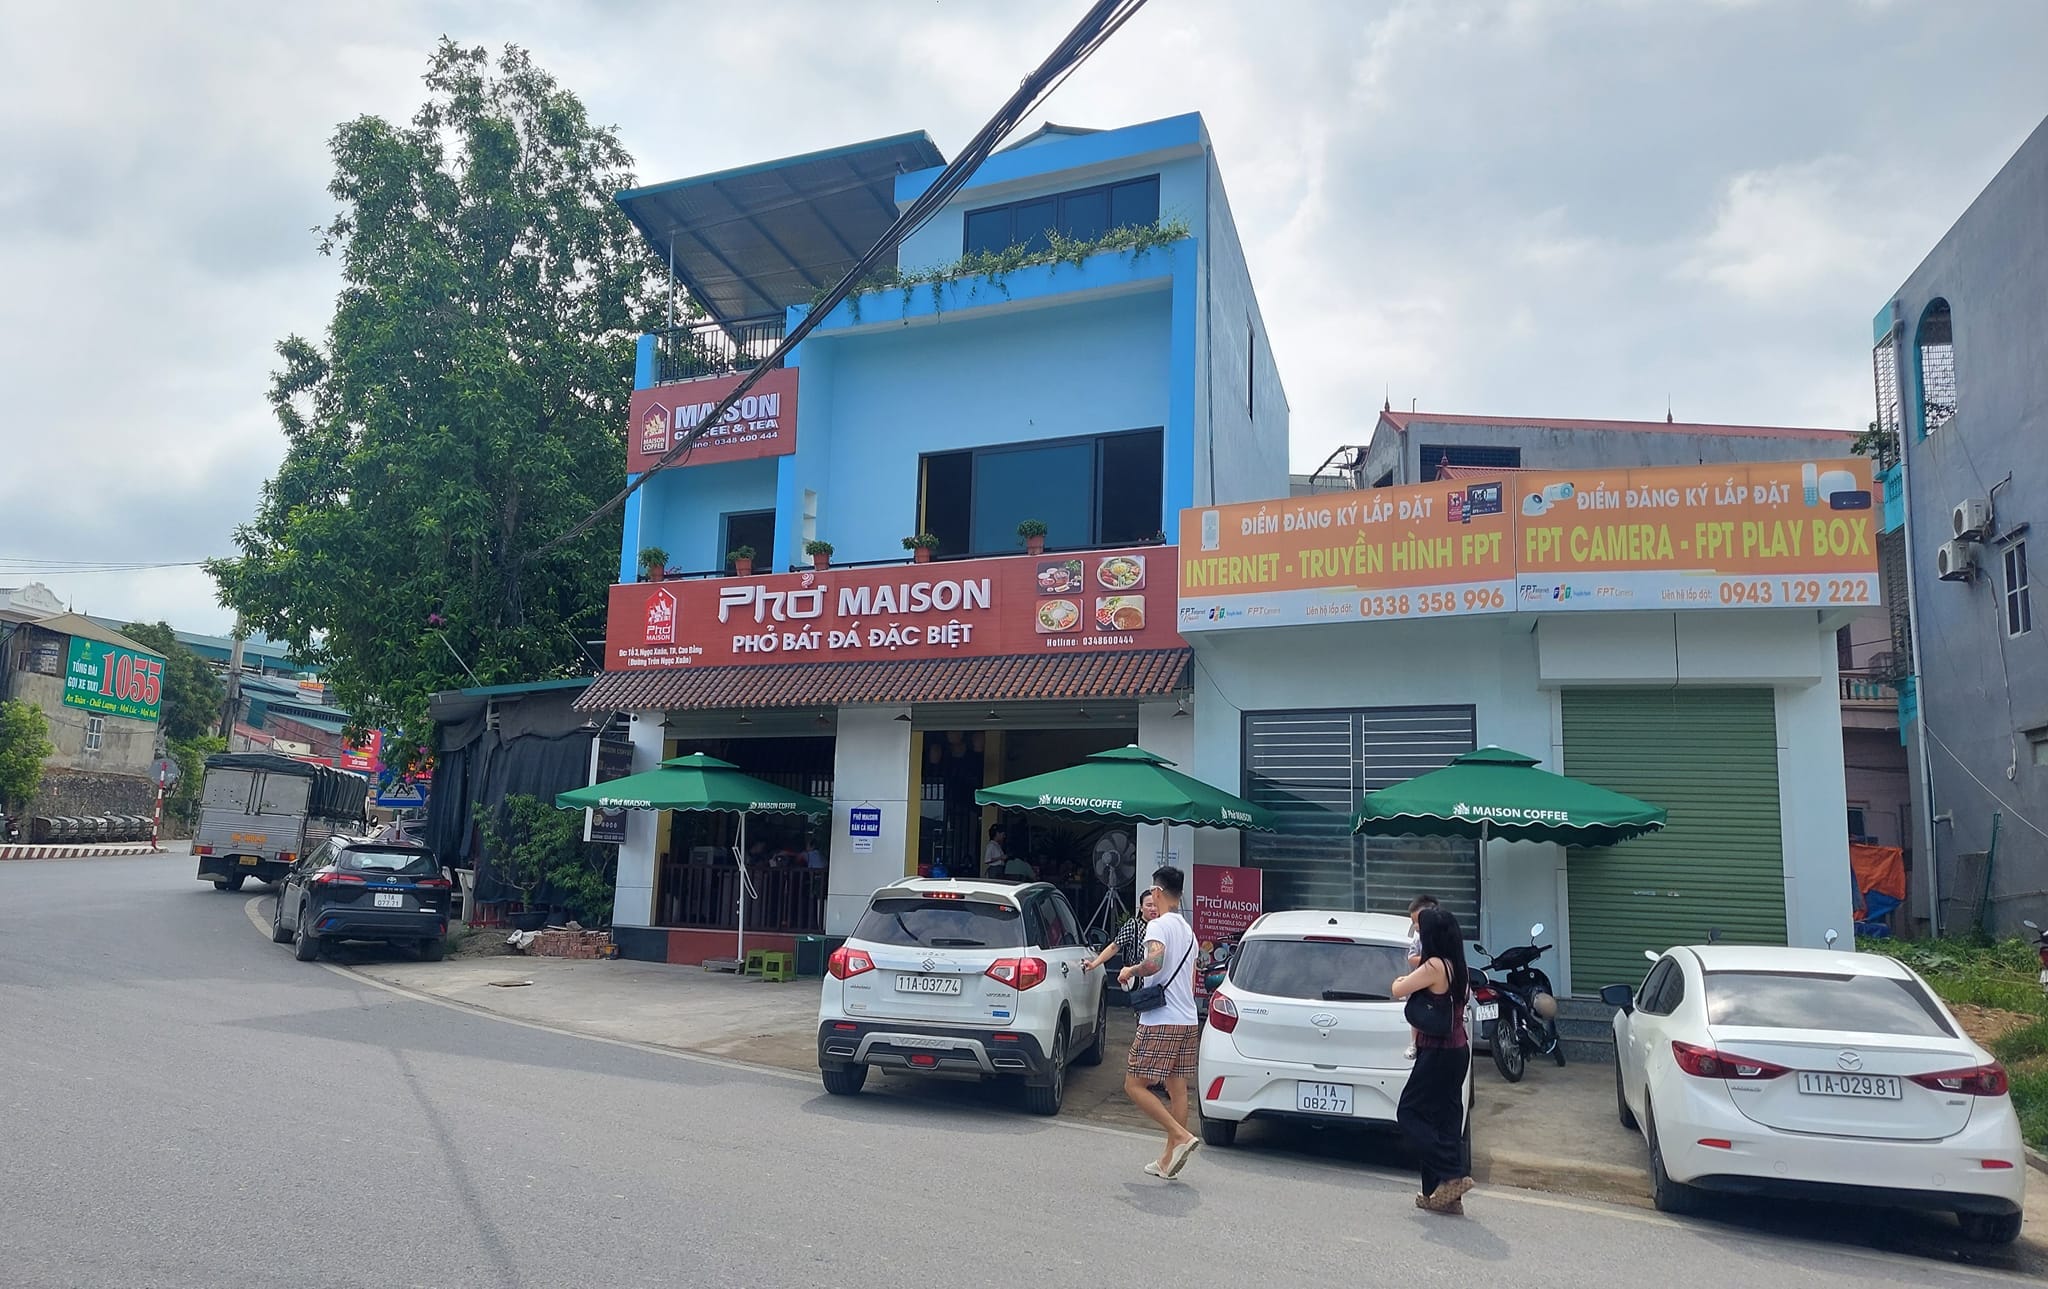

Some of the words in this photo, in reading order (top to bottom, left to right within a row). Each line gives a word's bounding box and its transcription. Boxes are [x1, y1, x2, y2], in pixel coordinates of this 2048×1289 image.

[674, 392, 781, 430] MASON
[733, 423, 746, 434] &
[748, 419, 779, 431] TEA
[643, 437, 666, 445] MAISON
[714, 437, 738, 446] 0348
[739, 434, 758, 443] 600
[760, 431, 778, 440] 444
[643, 442, 665, 451] COFFEE
[1577, 481, 1620, 510] ĐIỂM
[1625, 483, 1680, 508] ĐĂNG
[1685, 480, 1708, 507] KÝ
[1715, 477, 1747, 505] LẮP
[1753, 480, 1791, 509] ĐẶT
[1241, 505, 1279, 536] ĐIỂM
[1283, 507, 1332, 533] ĐĂNG
[1337, 501, 1357, 526] KÝ
[1364, 494, 1393, 524] LẮP
[1398, 494, 1433, 524] ĐẶT
[1525, 527, 1563, 563] FPT
[1570, 523, 1675, 562] CAMERA
[1695, 521, 1734, 560] FPT
[1742, 519, 1804, 558] PLAY
[1813, 518, 1871, 556] BOX
[1185, 553, 1280, 588] INTERNET
[1298, 528, 1383, 579] TRUYỀN
[1392, 531, 1452, 572] HÌNH
[1462, 532, 1502, 566] FPT
[717, 573, 828, 624] Phở
[837, 578, 991, 617] MAISON
[1597, 587, 1615, 597] FPT
[1719, 581, 1774, 604] 0943
[1781, 580, 1821, 603] 129
[1828, 580, 1870, 603] 222
[1359, 594, 1410, 617] 0338
[1418, 591, 1457, 614] 358
[1463, 588, 1505, 610] 996
[1248, 607, 1265, 616] FPT
[646, 623, 671, 635] Phở
[732, 624, 778, 653] PHỞ
[782, 623, 823, 651] BÁT
[828, 620, 862, 649] ĐÁ
[868, 622, 922, 651] ĐẶC
[927, 619, 974, 649] BIỆT
[1046, 637, 1079, 647] Hotline:
[1082, 634, 1134, 646] 0348600444
[78, 678, 86, 690] XE
[87, 680, 99, 693] TAXI
[98, 650, 162, 706] 1055
[623, 799, 651, 807] MAISON
[1052, 796, 1088, 807] MAISON
[1089, 798, 1123, 809] COFFEE
[1472, 806, 1521, 818] MAISON
[1523, 809, 1568, 821] COFFEE
[1196, 895, 1223, 909] Phở
[1223, 900, 1259, 913] MAISON
[898, 977, 959, 993] 11A-037.74
[1314, 1085, 1337, 1098] 11A
[1803, 1073, 1896, 1097] 11A-029.81
[1303, 1097, 1347, 1112] 082.77
